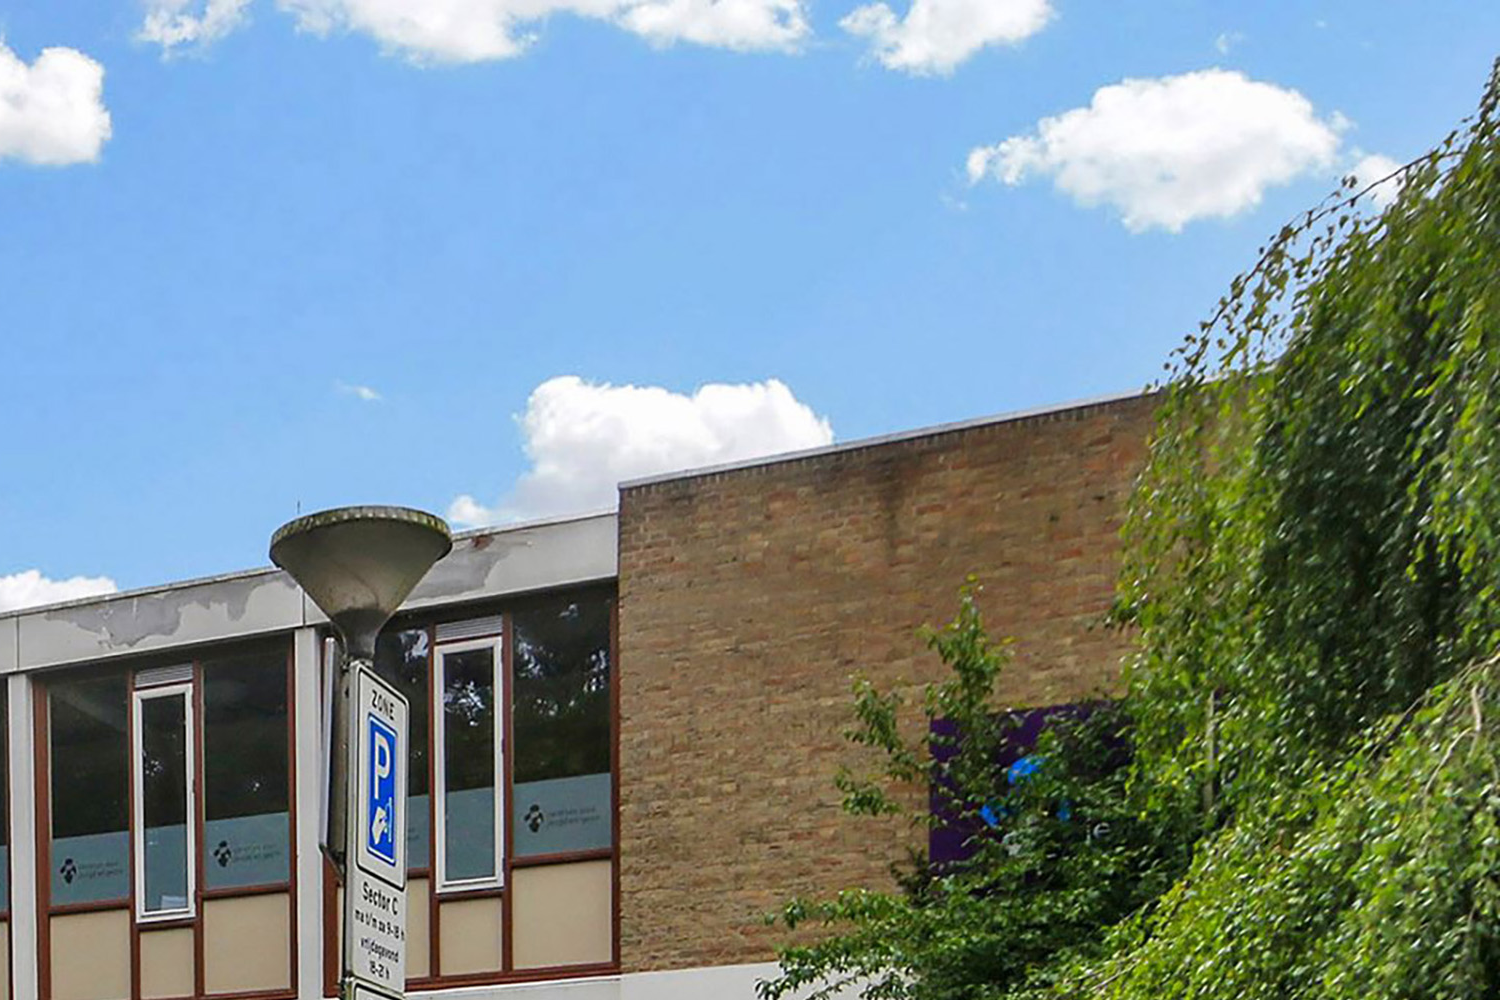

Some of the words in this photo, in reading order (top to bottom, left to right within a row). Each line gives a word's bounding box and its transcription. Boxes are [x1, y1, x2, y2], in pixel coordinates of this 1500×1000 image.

[371, 689, 395, 721] ZONE
[374, 731, 391, 800] P
[362, 881, 391, 912] Sector
[392, 896, 399, 916] C
